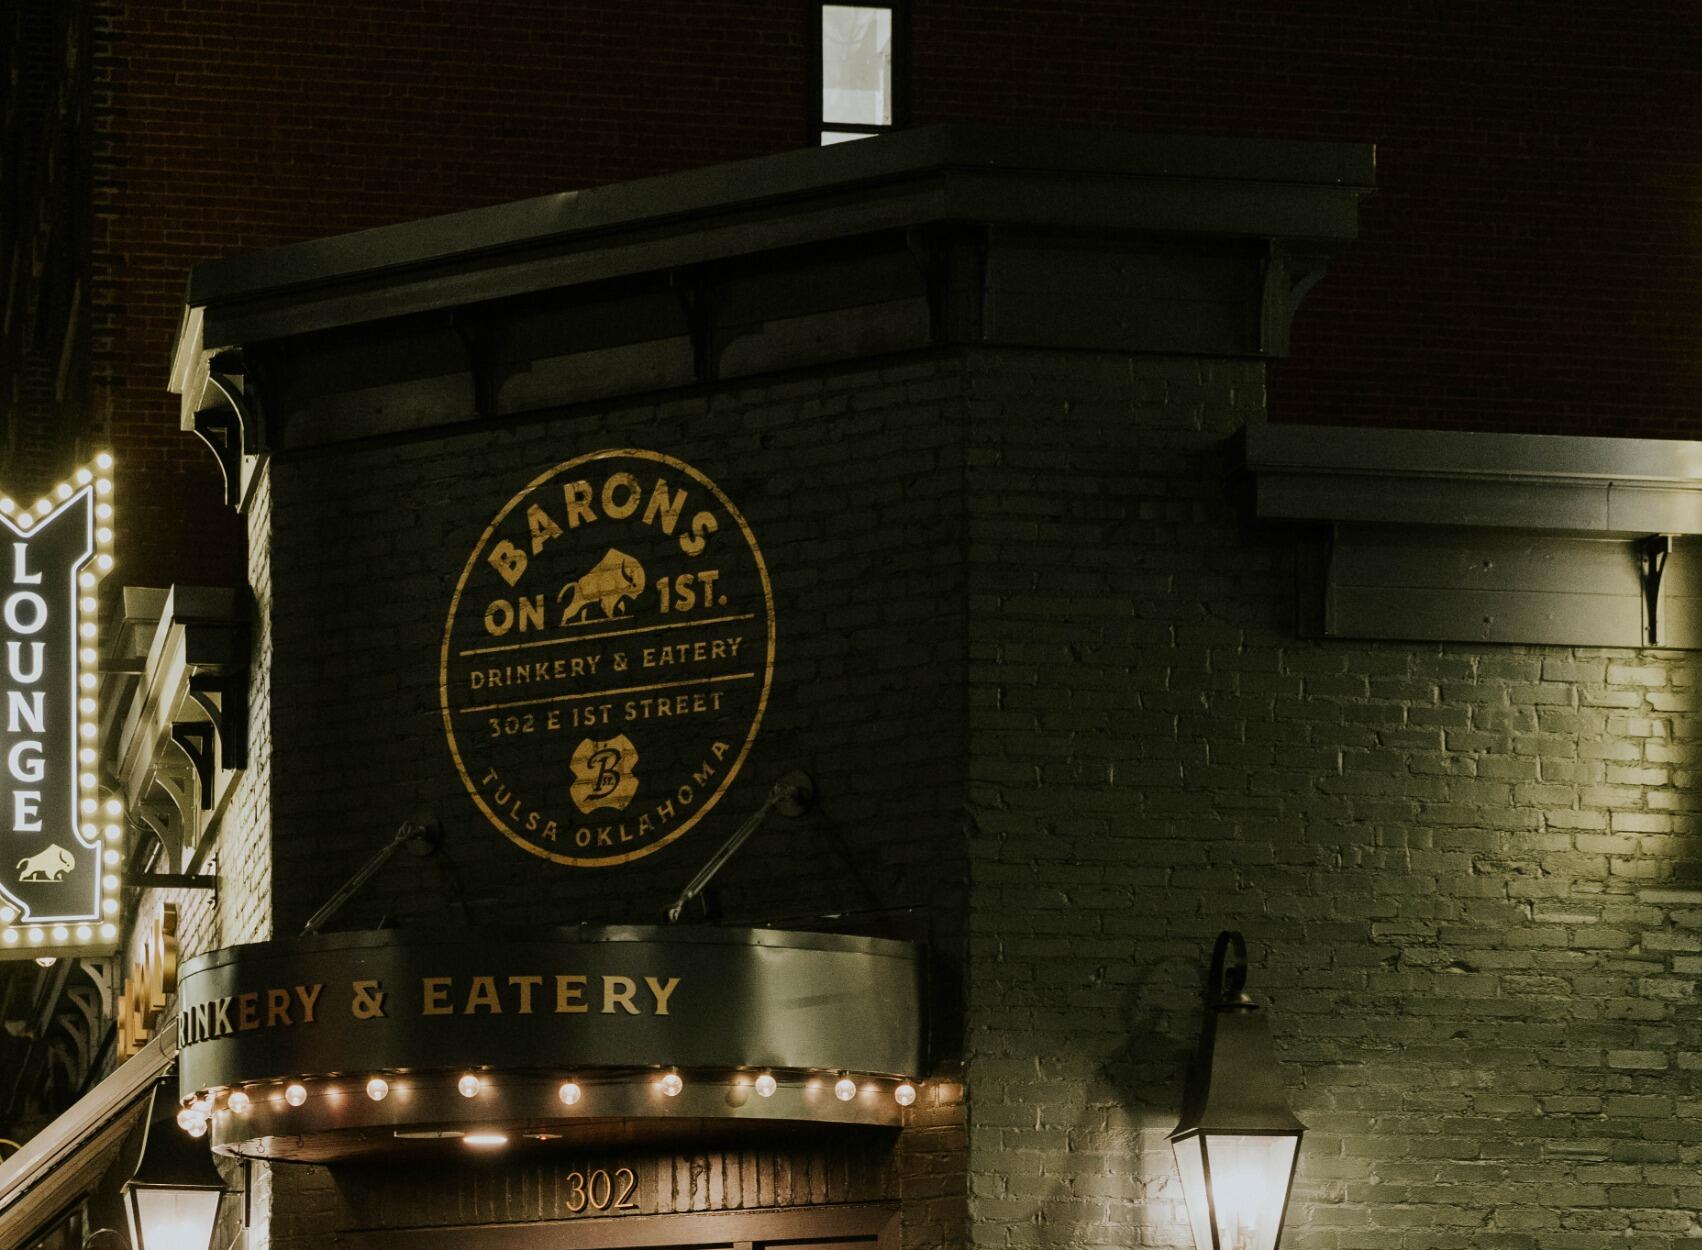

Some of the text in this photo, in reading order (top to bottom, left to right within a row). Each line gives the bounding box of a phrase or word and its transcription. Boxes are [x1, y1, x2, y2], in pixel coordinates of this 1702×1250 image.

[487, 471, 719, 587] BARONS
[484, 569, 727, 637] ON 1ST.
[4, 542, 48, 832] LOUNGE
[470, 636, 743, 690] DRINKERY & EATERY
[490, 692, 725, 737] 302 E 1ST STREET
[481, 739, 731, 849] TULSA OKLAHOMA
[177, 975, 682, 1050] RINKERY & EATERY
[566, 1168, 637, 1212] 302
